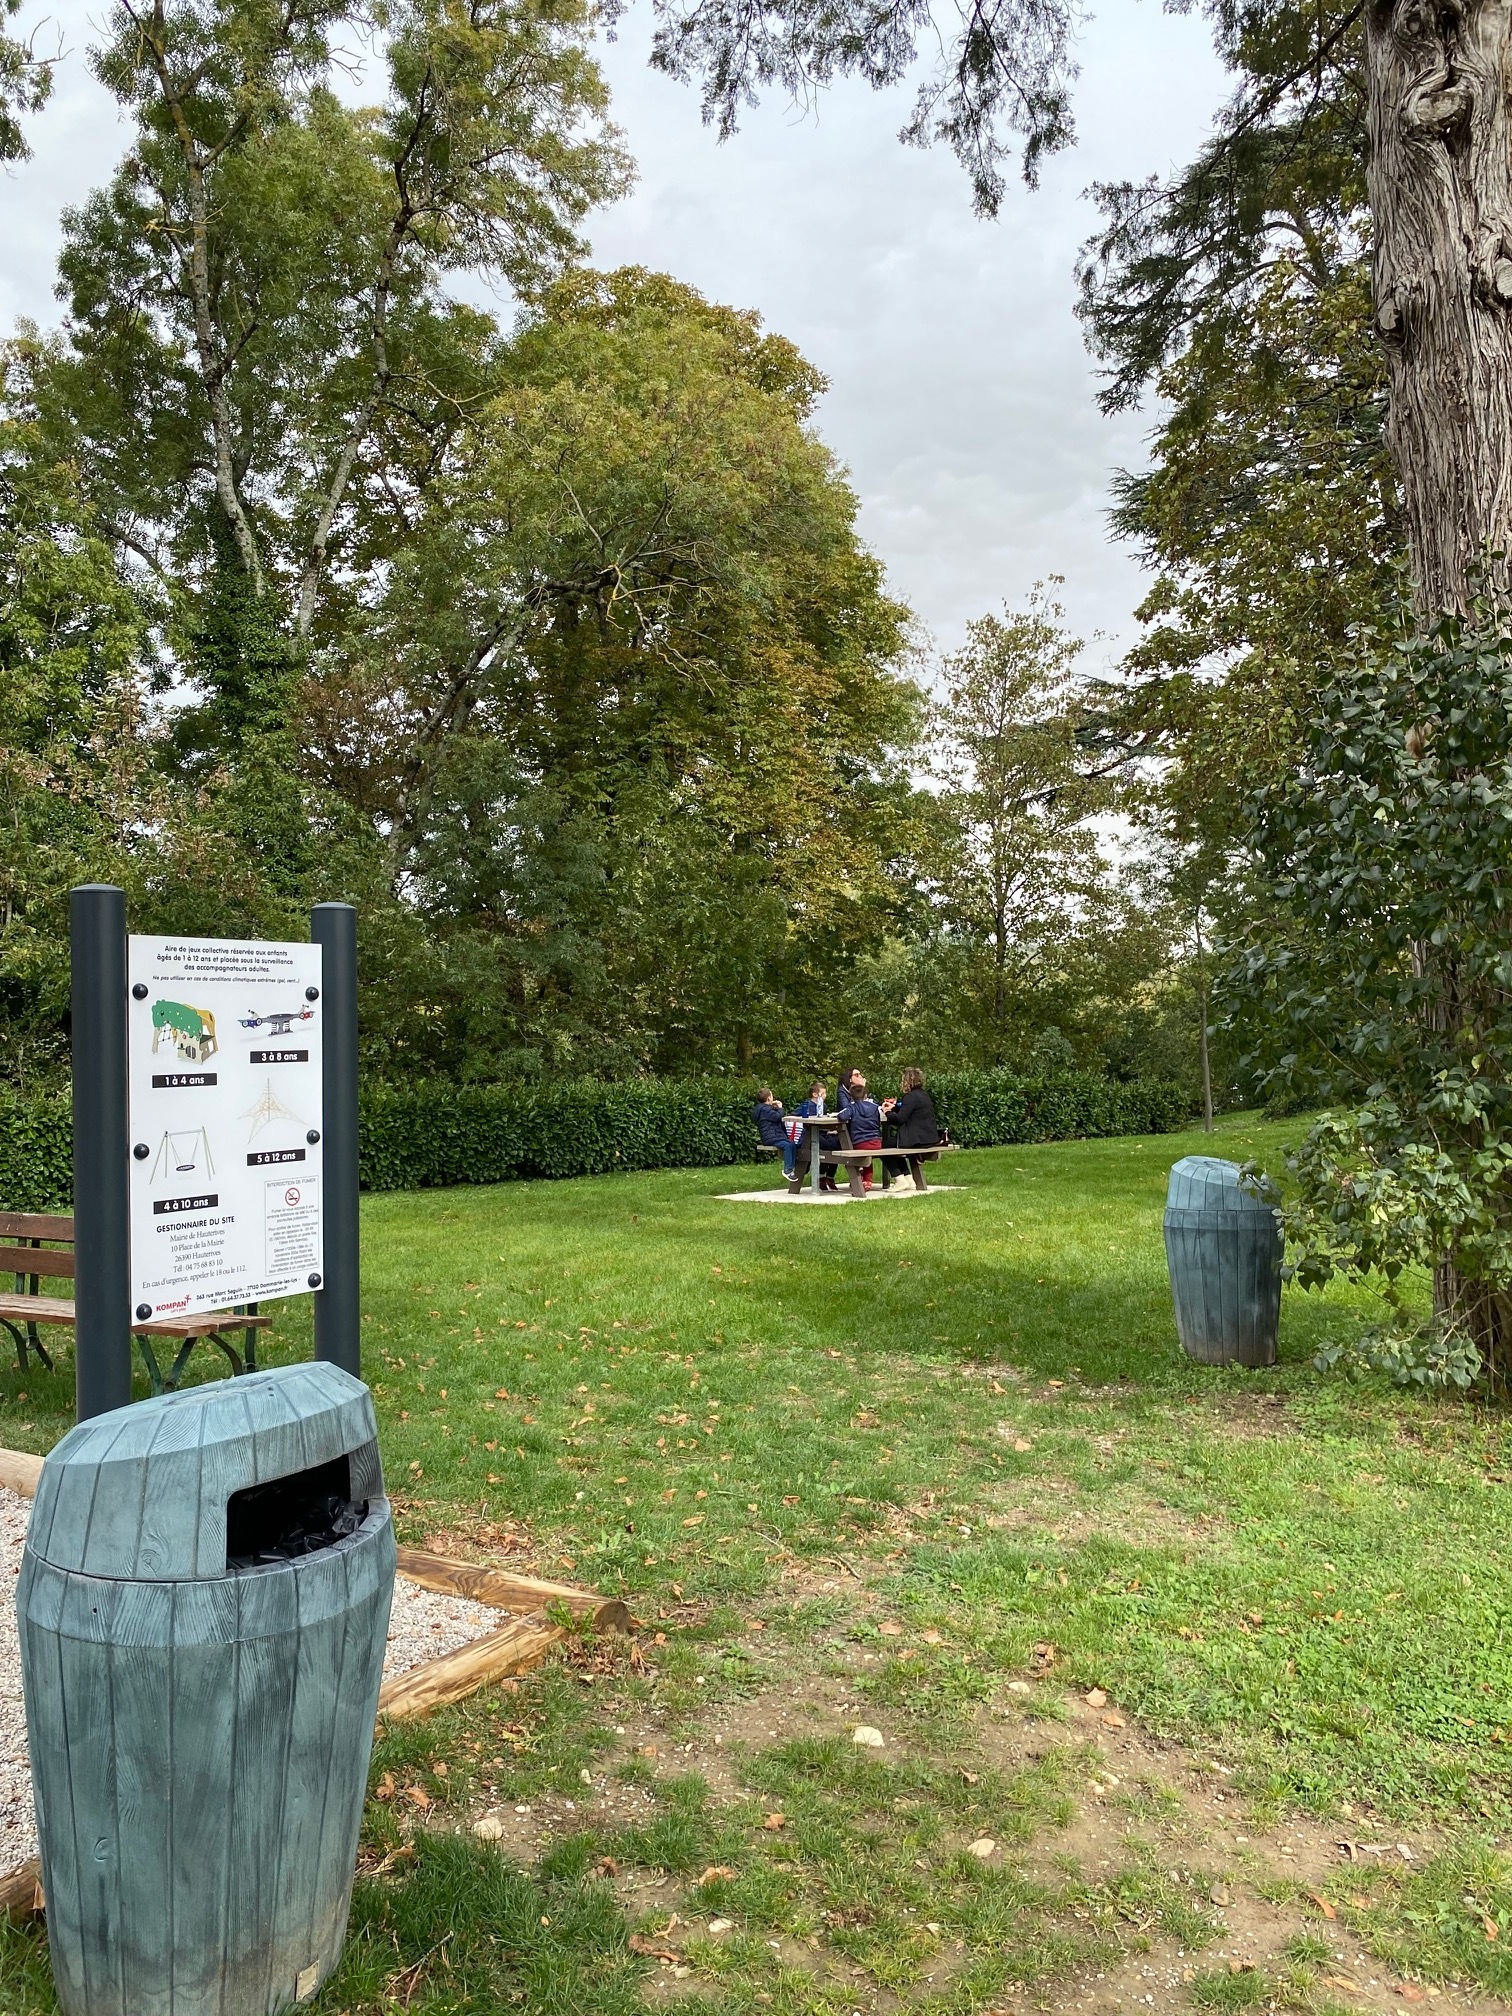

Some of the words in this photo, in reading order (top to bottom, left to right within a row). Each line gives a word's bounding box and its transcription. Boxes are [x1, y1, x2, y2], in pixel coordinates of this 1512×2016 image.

[230, 947, 254, 955] réservée
[156, 954, 172, 962] âgés
[261, 1053, 267, 1061] 3
[269, 1052, 275, 1061] à
[276, 1053, 282, 1061] 8
[165, 1076, 169, 1085] 1
[172, 1075, 178, 1085] à
[180, 1076, 187, 1085] 4
[257, 1155, 262, 1163] 5
[264, 1153, 270, 1162] à
[272, 1153, 280, 1161] 12
[164, 1202, 170, 1210] 4
[173, 1200, 178, 1210] à
[181, 1199, 190, 1209] 10
[193, 1199, 208, 1207] ans
[156, 1219, 207, 1233] GESTIONNAIRE
[209, 1218, 219, 1226] DU
[222, 1216, 235, 1224] SITE
[170, 1234, 188, 1242] Mairie
[197, 1229, 225, 1238] Hauterives
[207, 1239, 224, 1247] Mairie
[175, 1254, 191, 1262] 26390
[192, 1250, 221, 1259] Hauterives
[190, 1272, 209, 1282] appeler
[156, 1300, 186, 1311] KOMPAN
